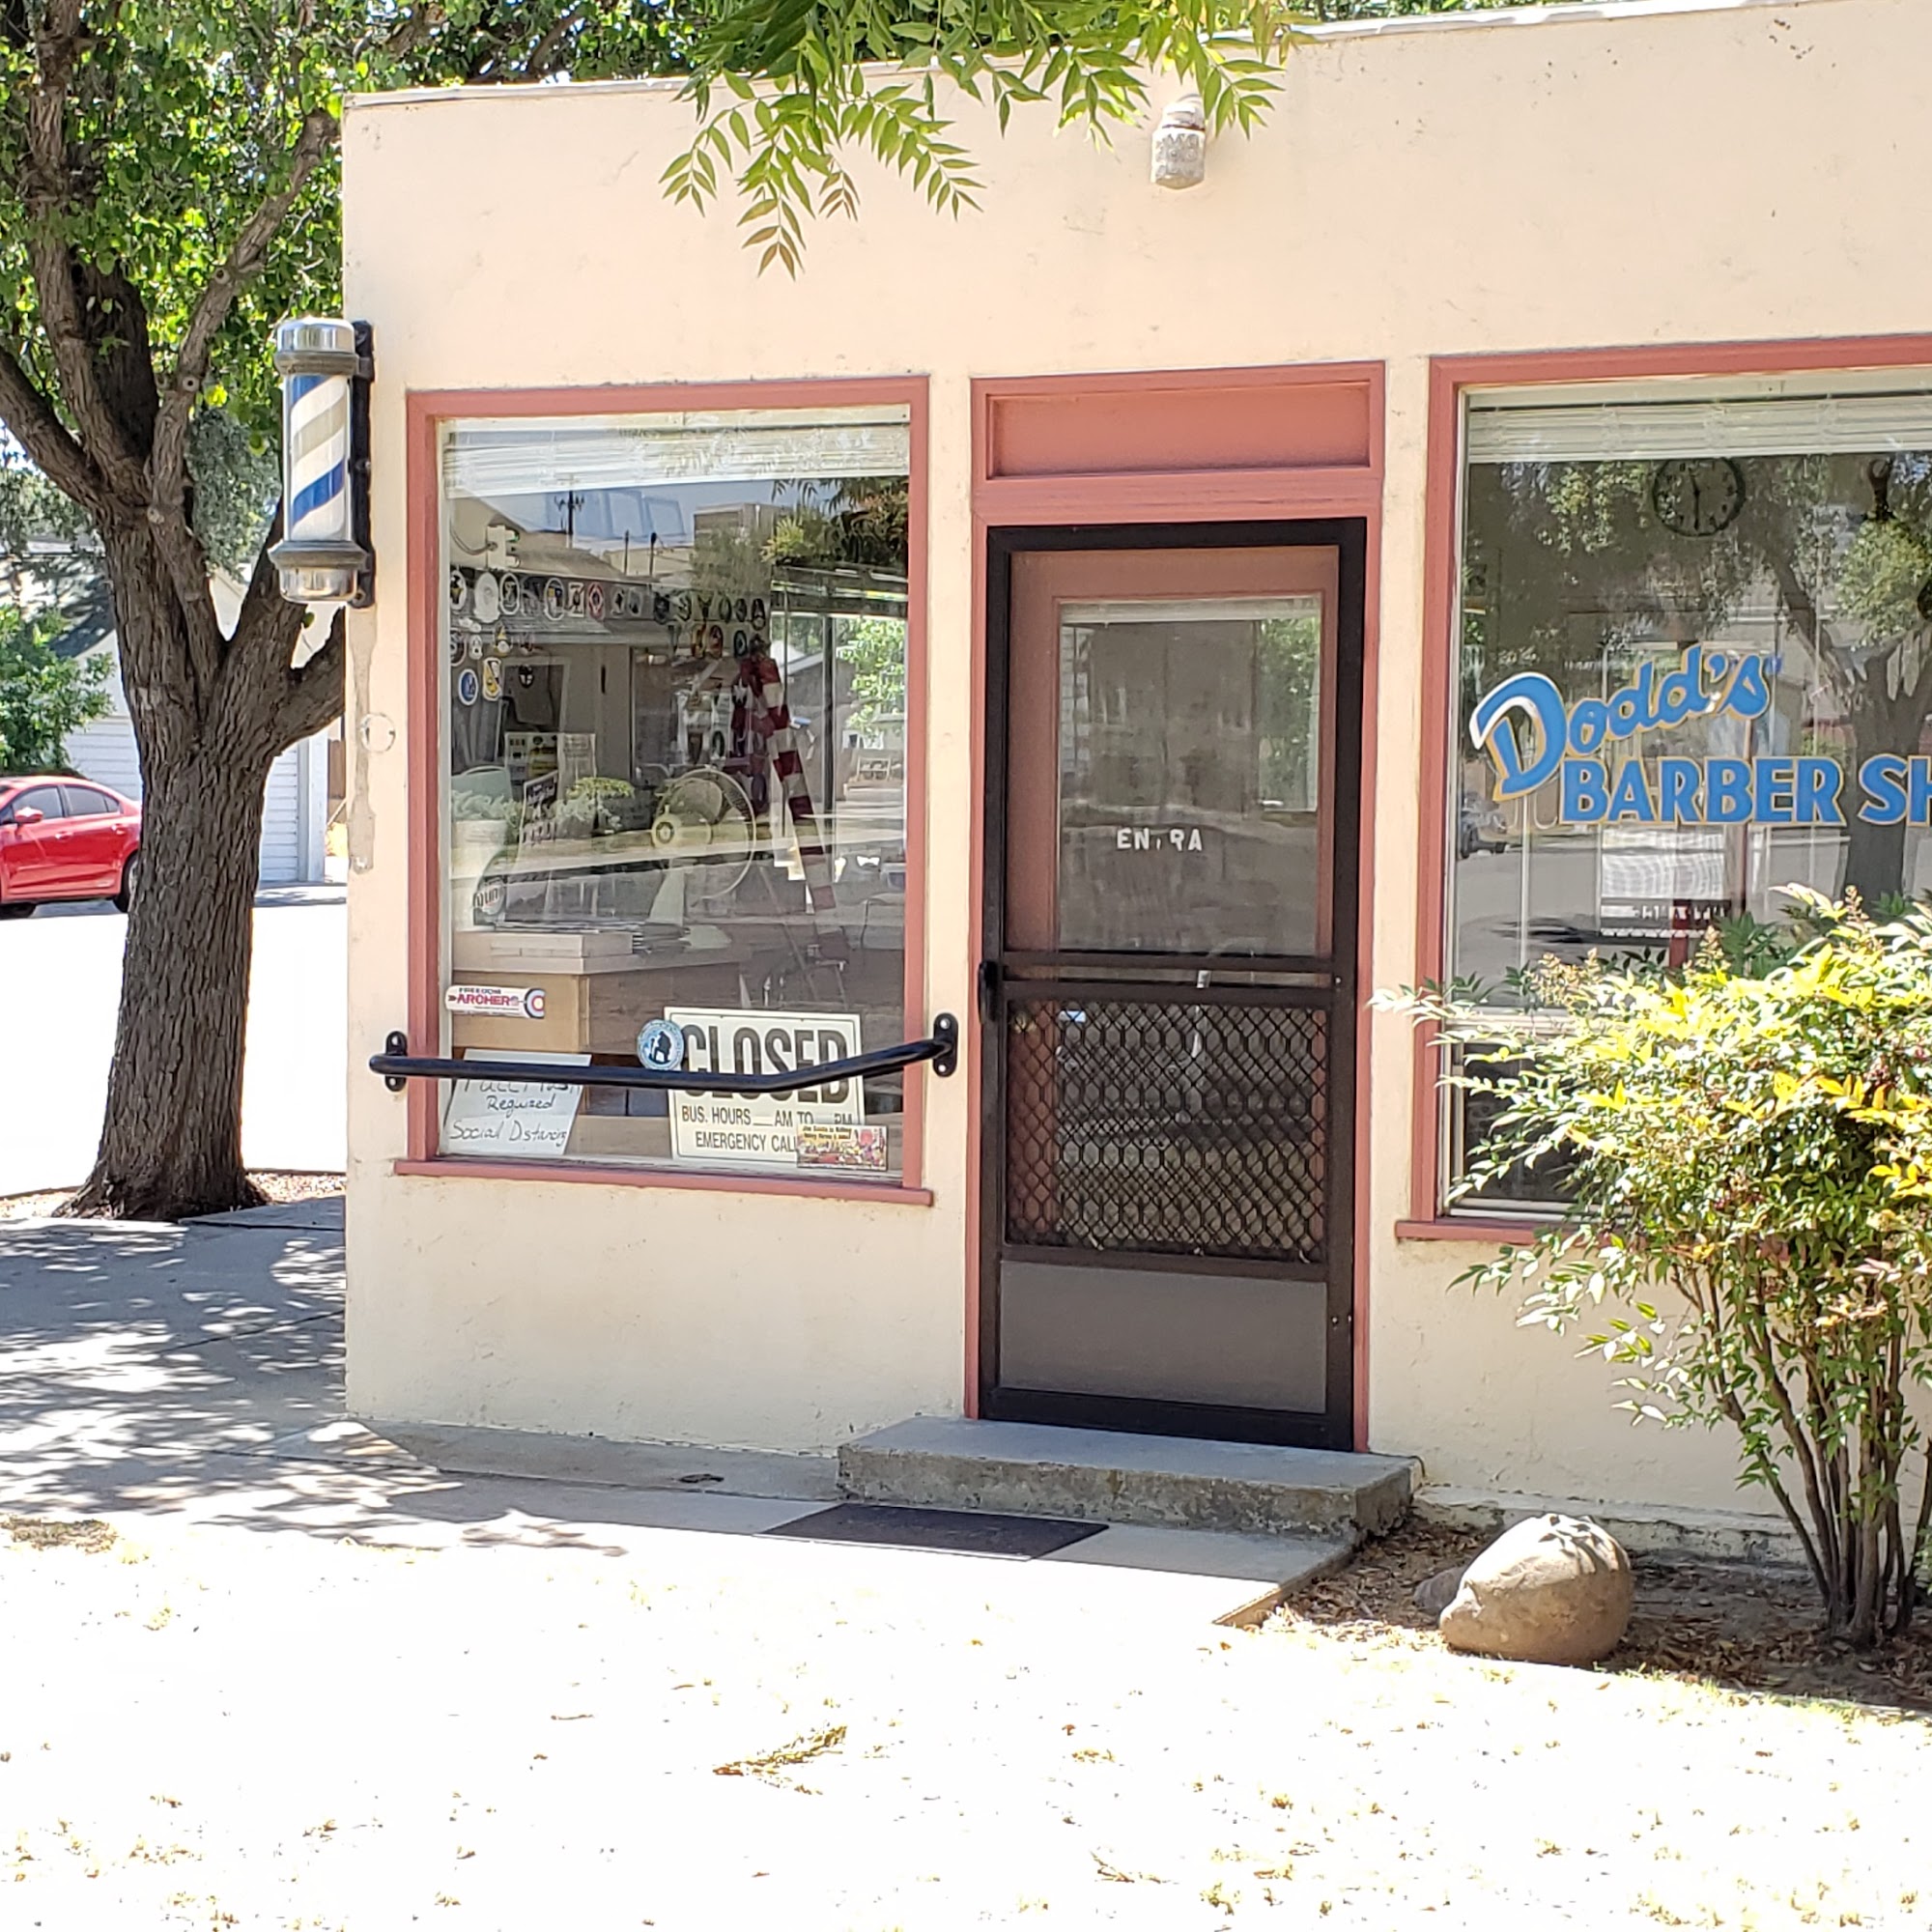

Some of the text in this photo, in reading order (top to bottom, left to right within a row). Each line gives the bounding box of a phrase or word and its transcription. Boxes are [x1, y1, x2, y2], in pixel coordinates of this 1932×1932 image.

[1468, 642, 1770, 801] Dodd's
[1560, 756, 1846, 826] BARBER
[681, 1024, 850, 1103] CLOSED
[449, 1120, 504, 1140] Social
[682, 1105, 708, 1123] BUS.
[712, 1107, 752, 1125] HOURS
[774, 1110, 793, 1127] AM
[797, 1111, 814, 1124] TO
[696, 1131, 767, 1151] EMERGENCY
